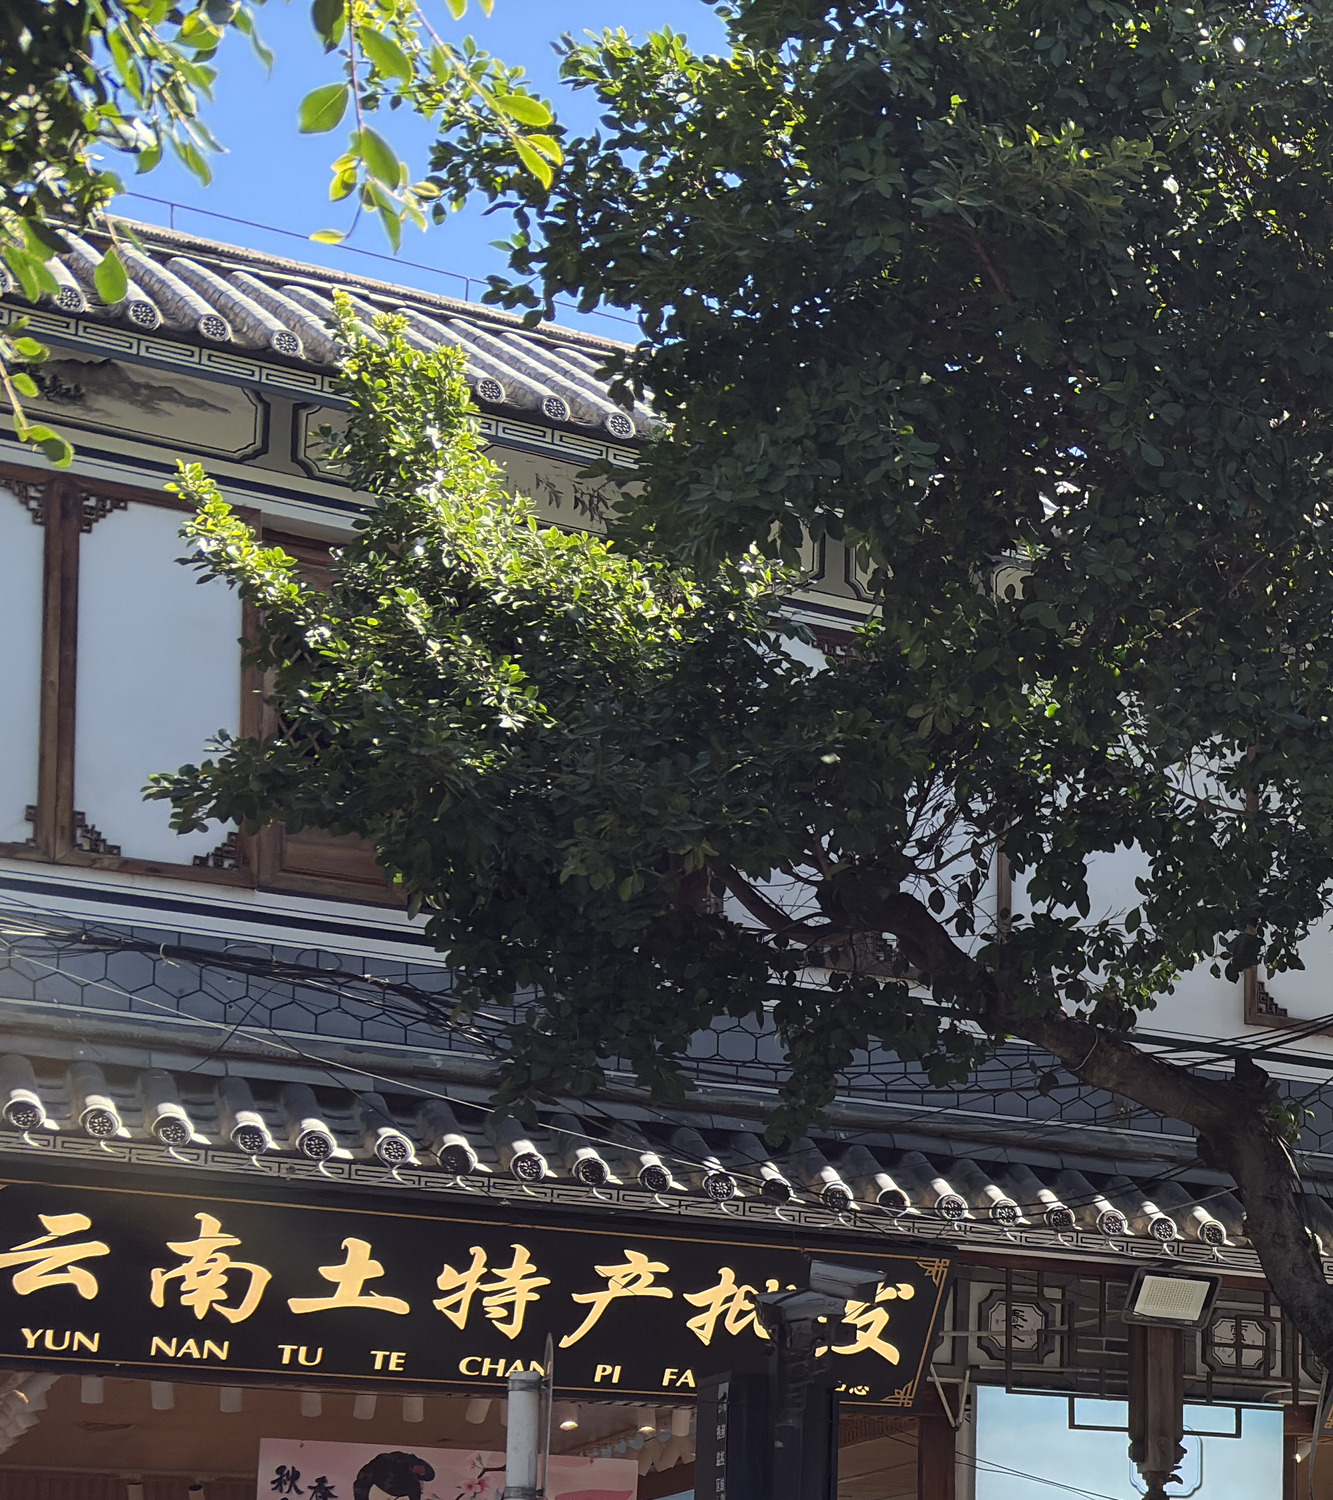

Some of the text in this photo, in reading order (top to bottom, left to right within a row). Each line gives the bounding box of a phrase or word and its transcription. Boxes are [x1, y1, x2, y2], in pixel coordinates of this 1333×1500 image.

[21, 1328, 100, 1353] YUN
[150, 1337, 229, 1361] NAN
[277, 1344, 323, 1366] TU
[370, 1350, 406, 1371] TE
[594, 1364, 620, 1384] PI
[662, 1368, 696, 1388] FA
